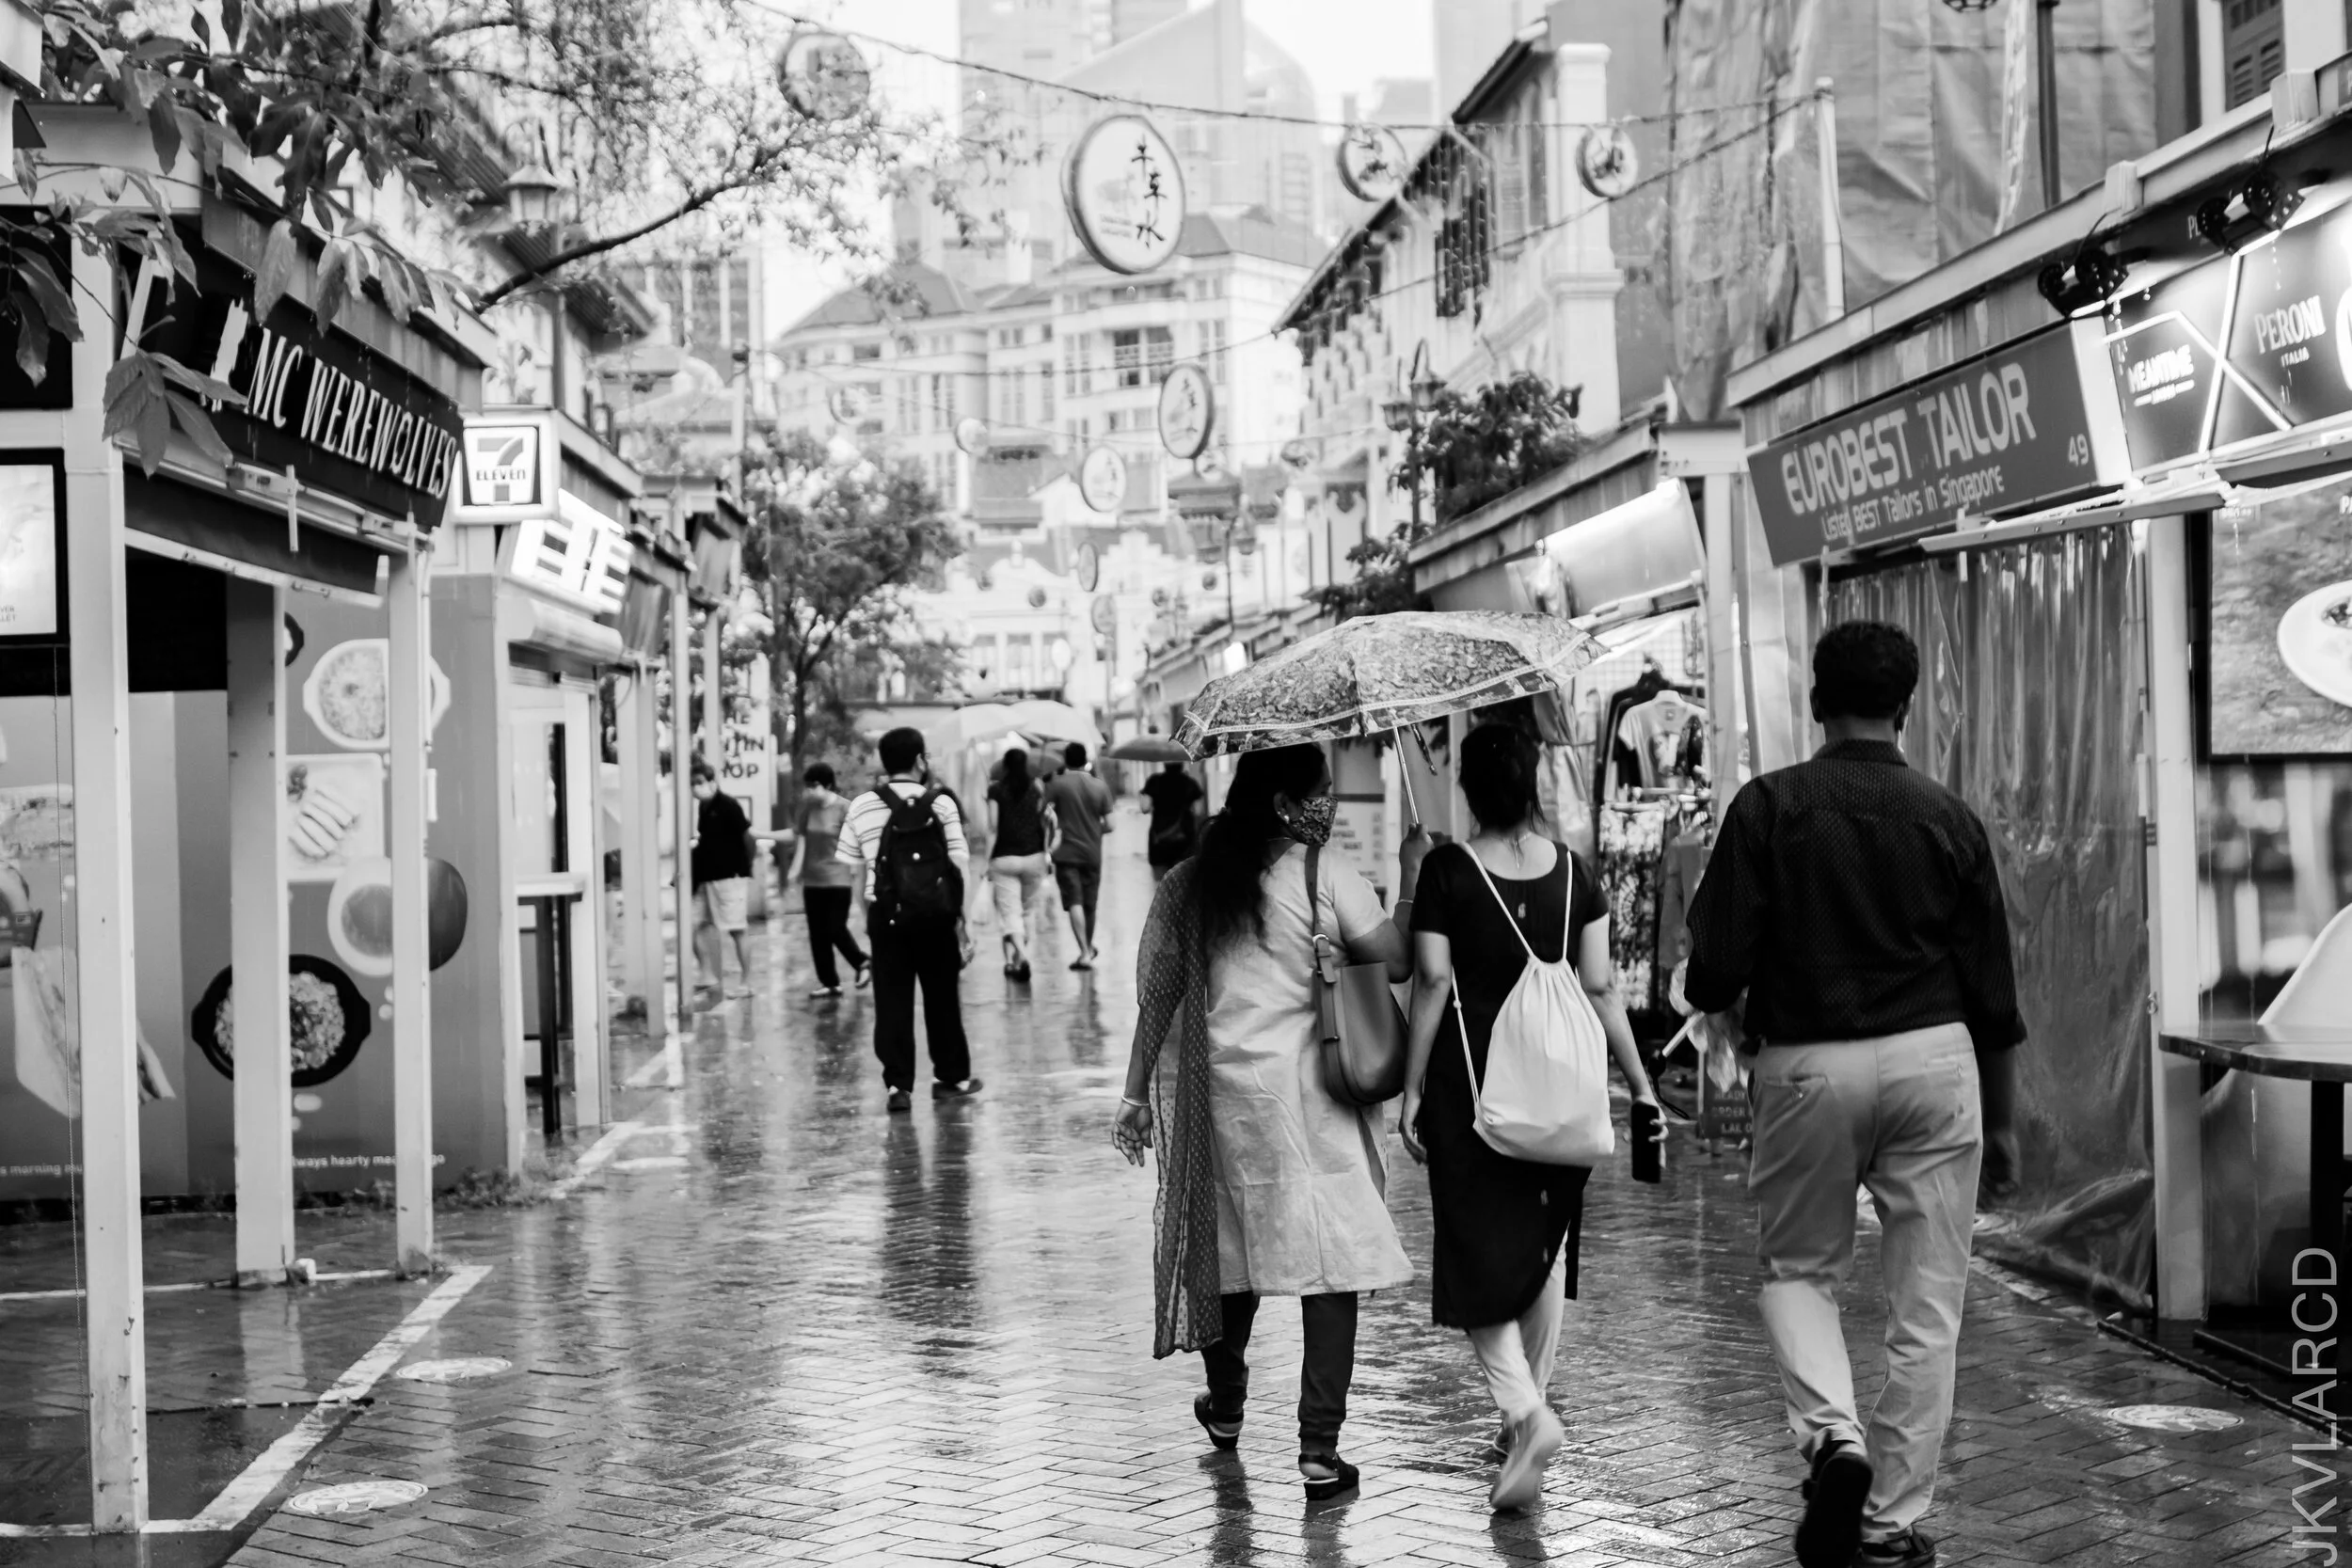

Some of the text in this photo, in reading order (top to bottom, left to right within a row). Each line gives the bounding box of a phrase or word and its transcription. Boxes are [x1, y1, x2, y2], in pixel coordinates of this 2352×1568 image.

[2254, 294, 2326, 355] PERONI
[2280, 346, 2311, 368] ITALIA
[244, 326, 456, 499] MC WEREWOLVES
[1782, 362, 2037, 515] EUROBEST TAILOR
[2068, 433, 2090, 467] 49
[1852, 499, 1881, 532] BEST
[1882, 488, 1924, 523] Tailors
[1923, 480, 1938, 512] in
[9, 1163, 62, 1178] morning
[292, 1155, 328, 1171] lways
[330, 1154, 370, 1169] hearty
